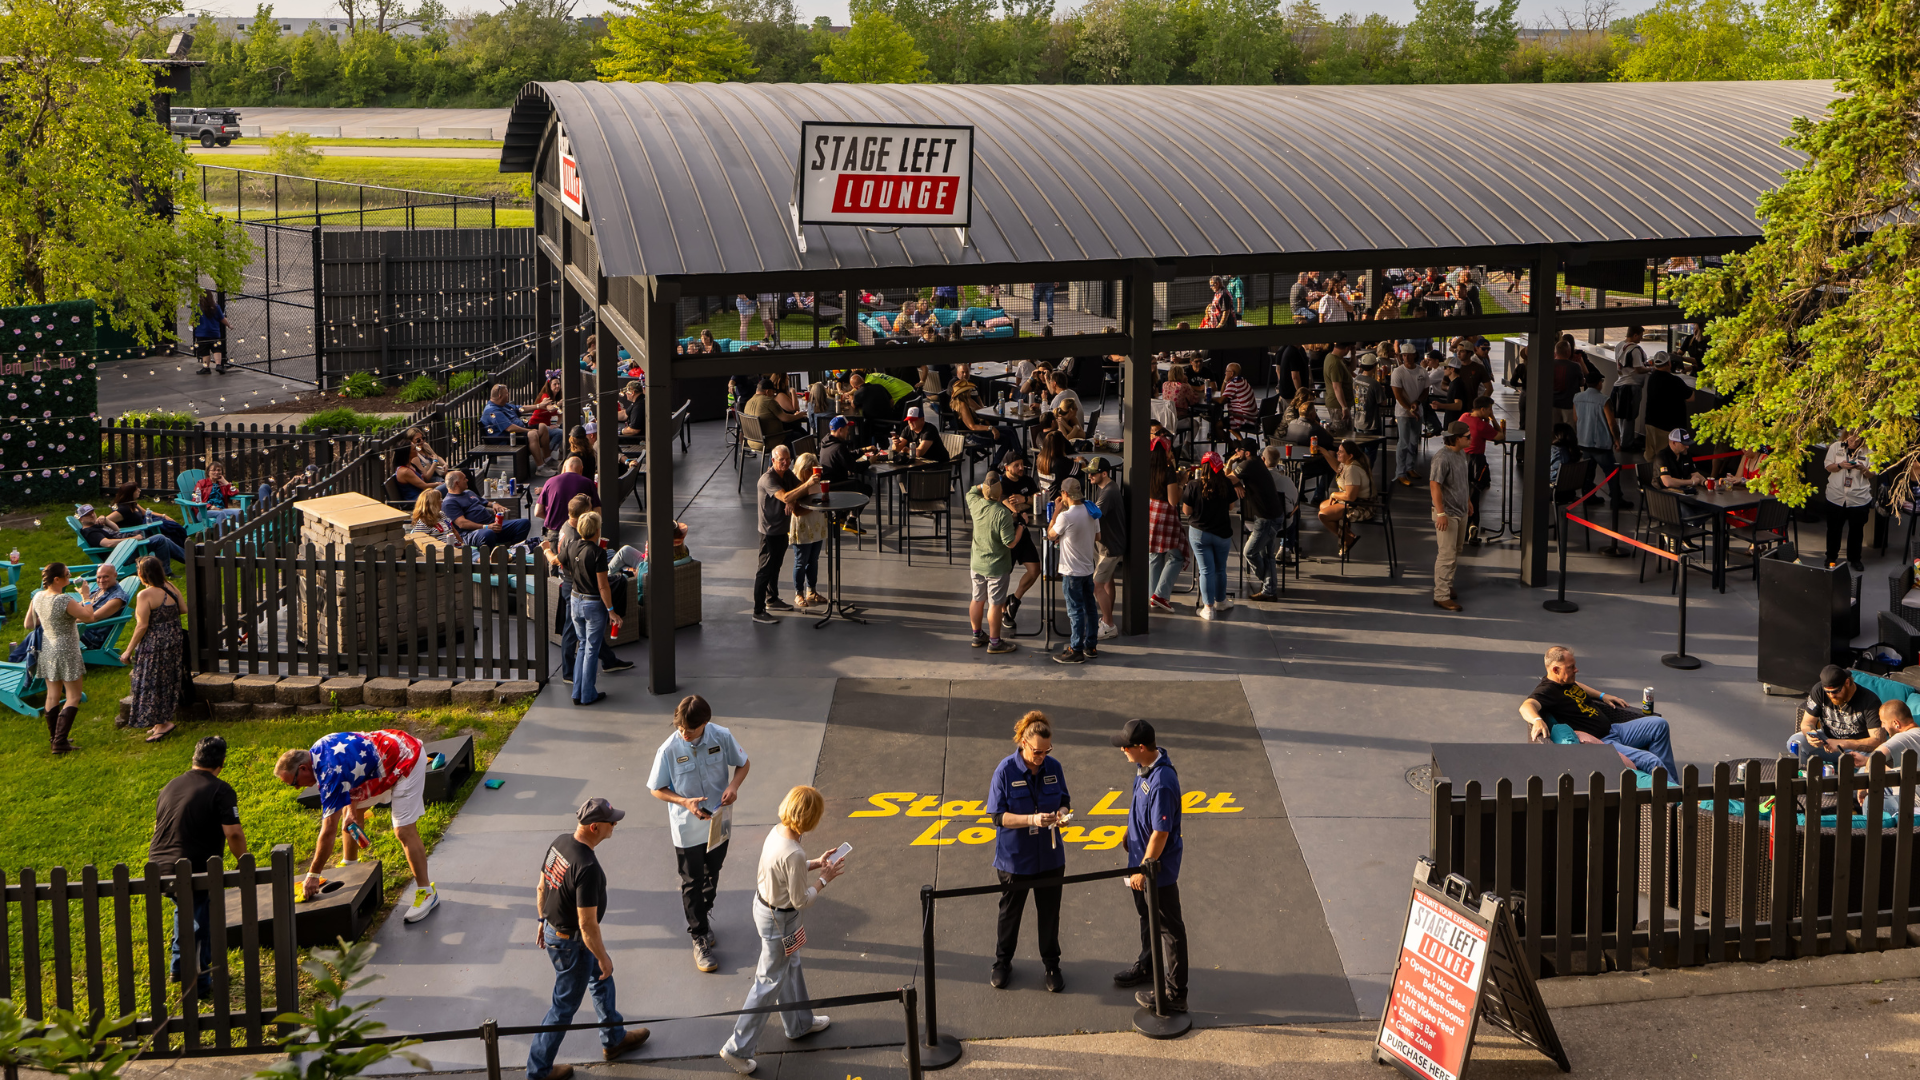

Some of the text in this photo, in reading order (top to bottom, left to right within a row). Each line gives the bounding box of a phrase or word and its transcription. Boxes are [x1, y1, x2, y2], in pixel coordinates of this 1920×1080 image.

[811, 135, 957, 173] STAGE LEFT
[843, 180, 949, 209] LOUNGE
[60, 356, 76, 370] me
[1439, 905, 1453, 919] YOUR
[1414, 905, 1478, 958] STAGE LEFT
[1410, 958, 1455, 992] Opens 1 Hour
[1422, 937, 1470, 978] LOUNGE
[1404, 981, 1465, 1028] Private Restrooms
[1422, 977, 1466, 1013] Before Gates
[1398, 1006, 1437, 1039] Express Bar
[1401, 993, 1455, 1036] LIVE Video Feed
[1395, 1020, 1433, 1052] Game Zone
[1386, 1033, 1450, 1080] PURCHASE HERE
